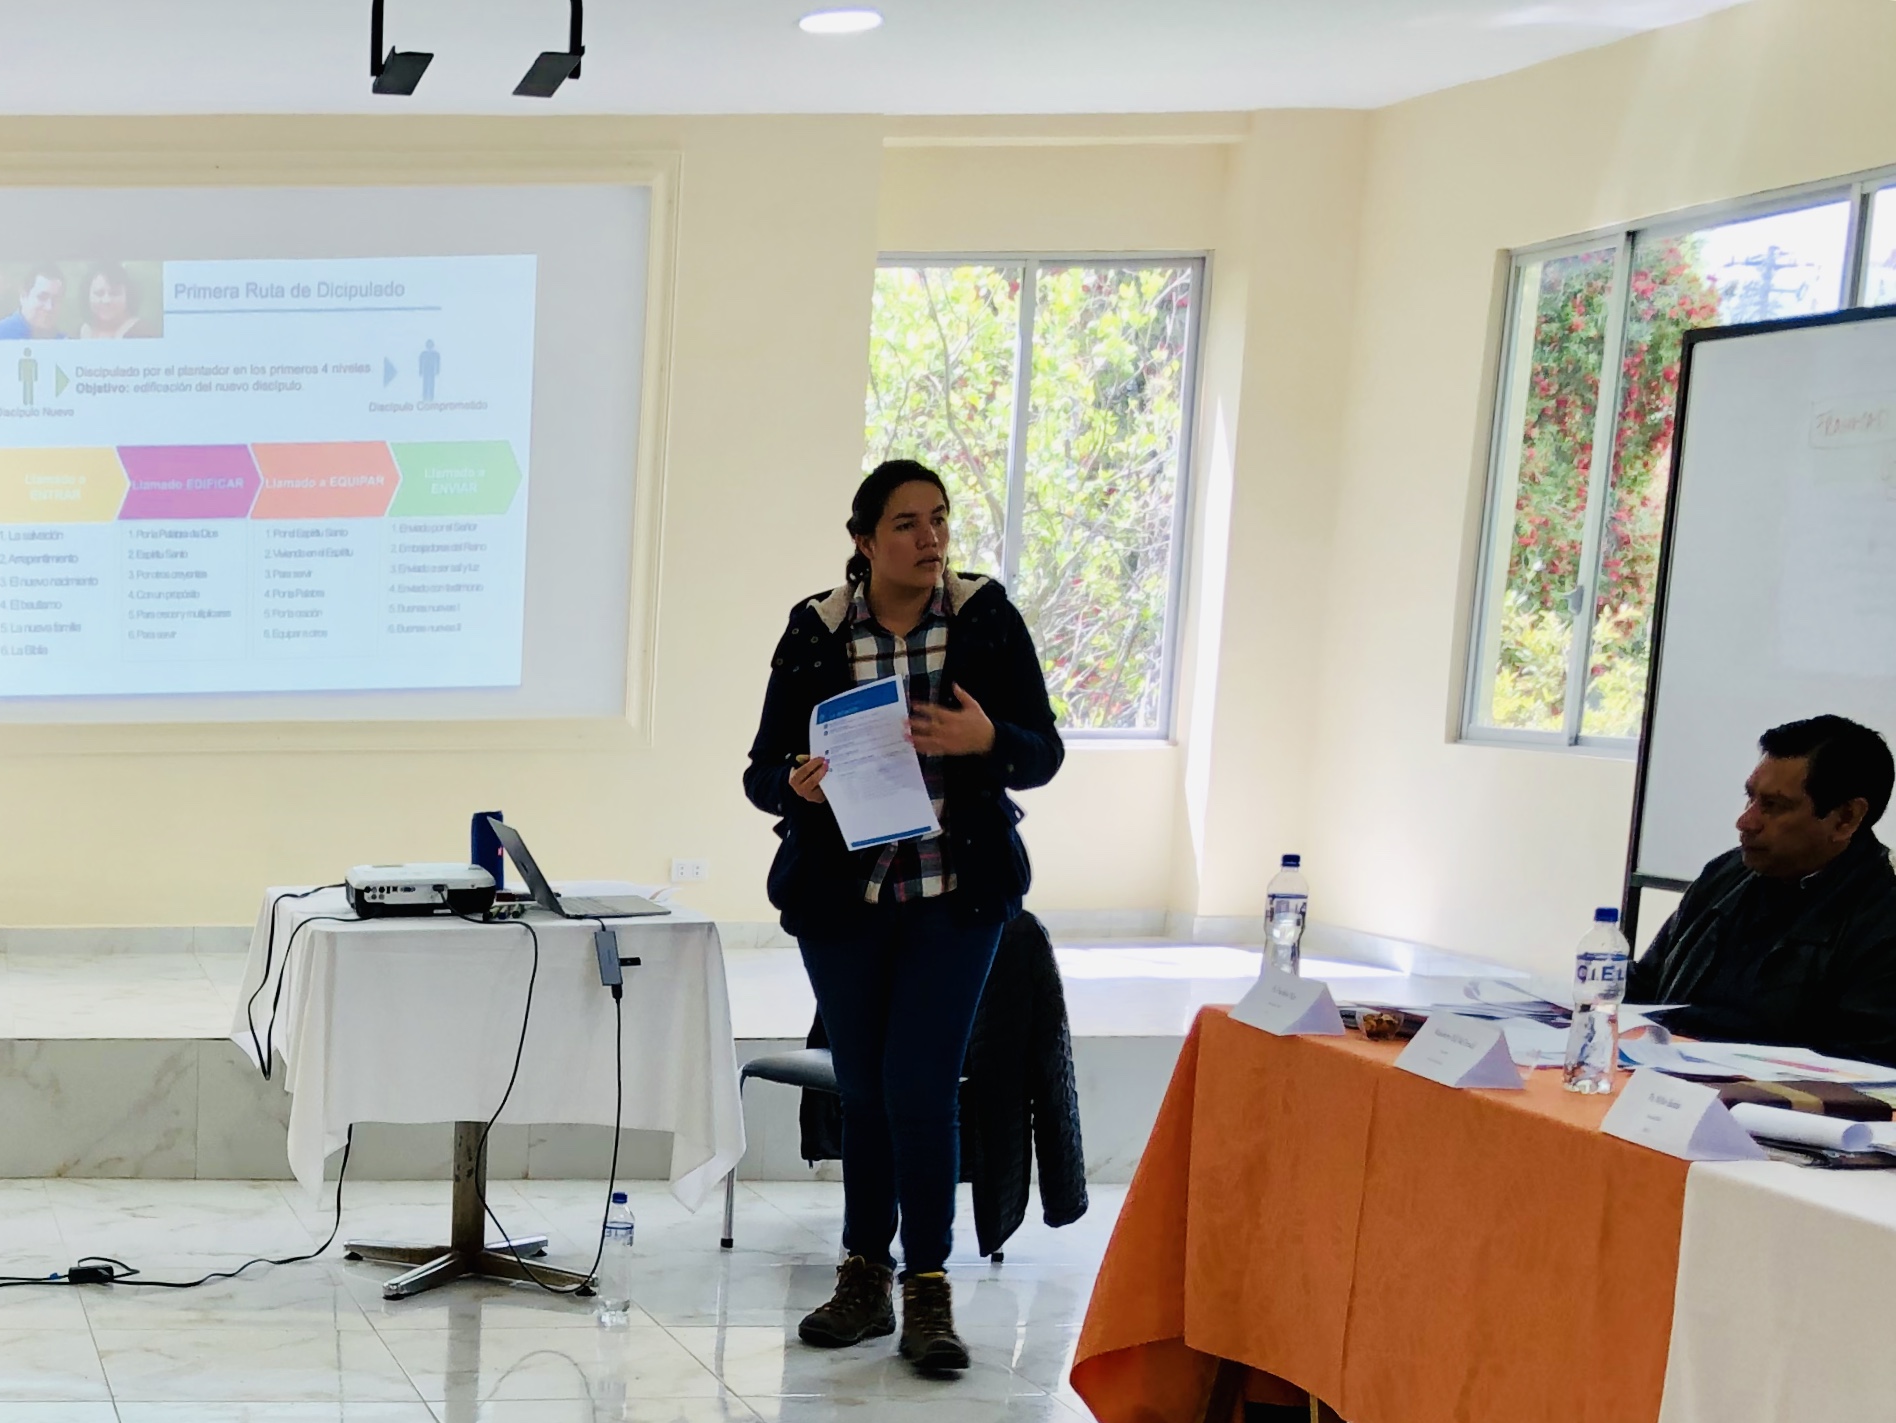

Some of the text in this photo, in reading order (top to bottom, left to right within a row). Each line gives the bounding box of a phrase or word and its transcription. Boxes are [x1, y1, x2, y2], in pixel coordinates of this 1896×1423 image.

[174, 281, 405, 301] Primera Ruta de Dicipulado
